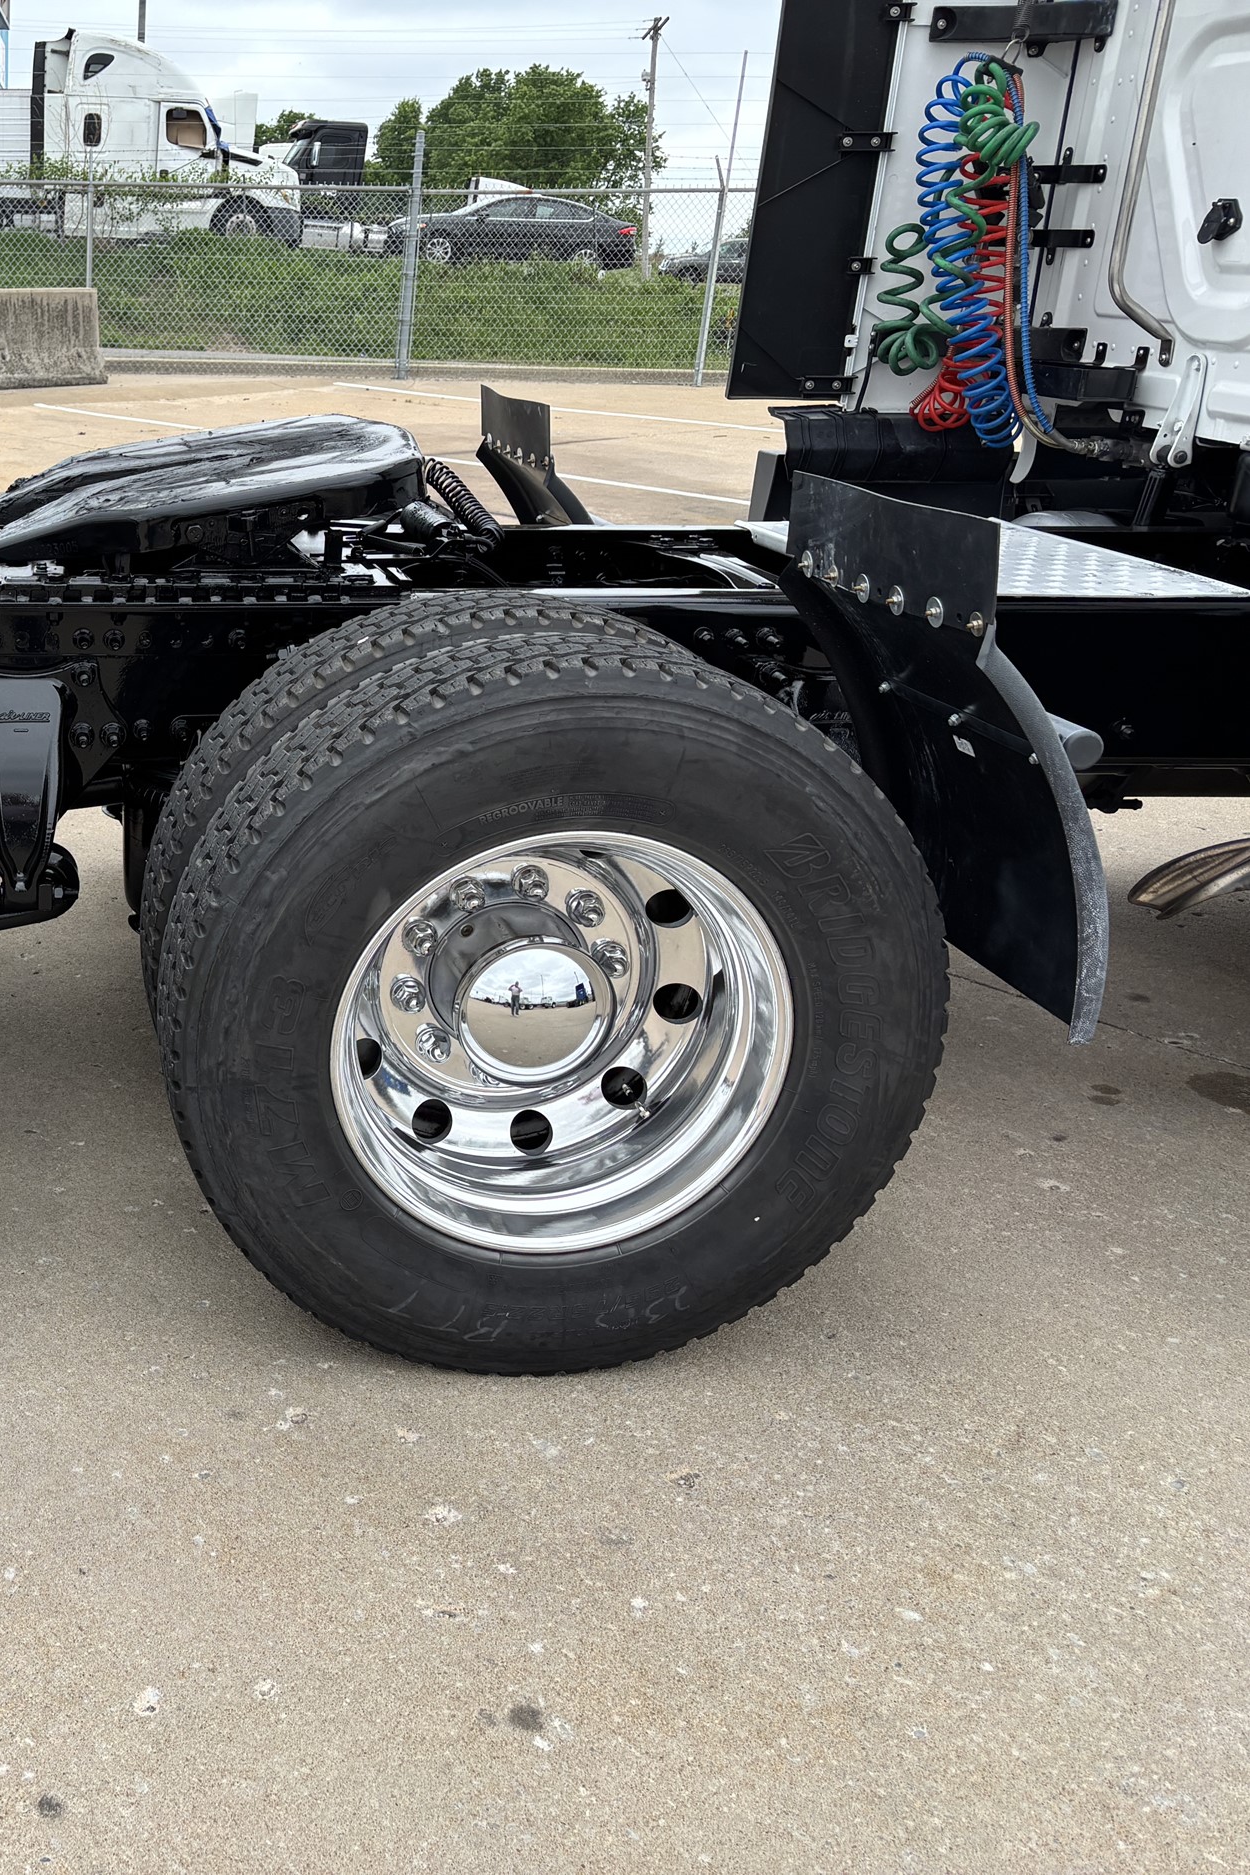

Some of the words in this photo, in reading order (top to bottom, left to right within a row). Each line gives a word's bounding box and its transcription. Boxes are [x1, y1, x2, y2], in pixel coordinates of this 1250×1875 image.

[478, 796, 569, 827] REGROOVABLE
[254, 974, 334, 1209] M713
[763, 832, 884, 1214] BRIDGESTONE
